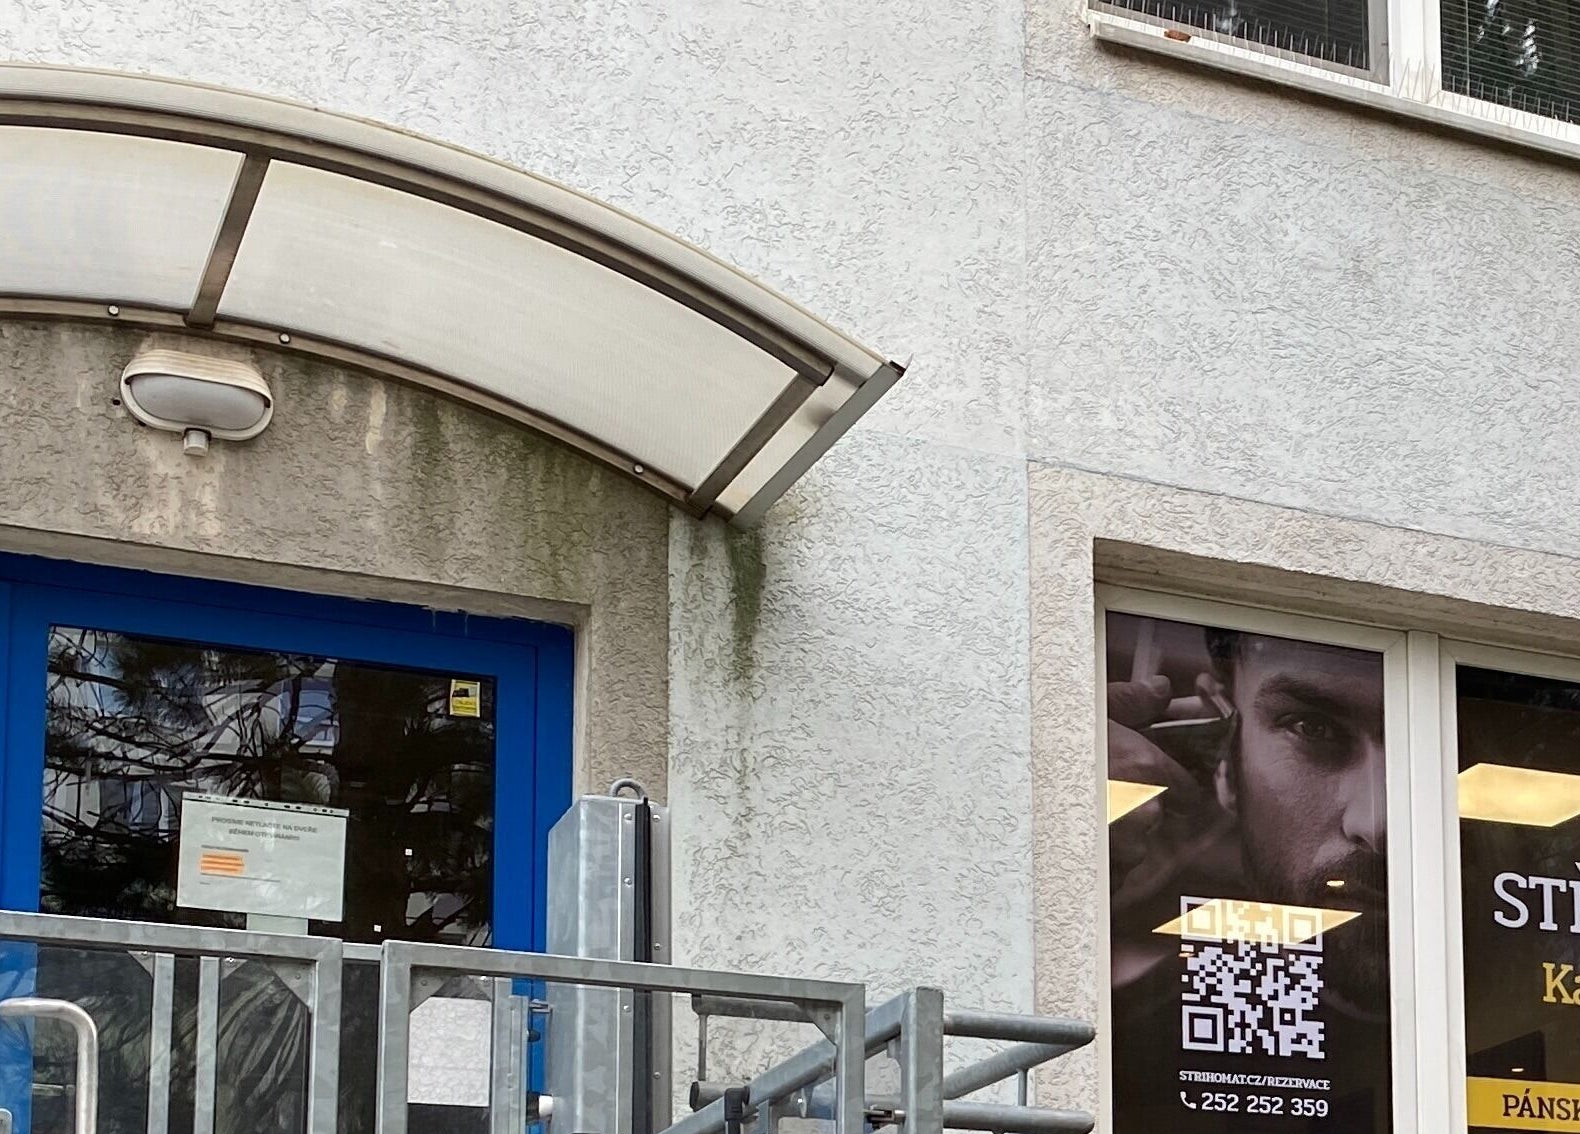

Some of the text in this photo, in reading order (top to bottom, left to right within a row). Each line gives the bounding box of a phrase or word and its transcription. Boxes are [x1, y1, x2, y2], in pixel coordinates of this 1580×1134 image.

[1179, 1070, 1331, 1091] STRIHOMAT.CZ/REZERVACE
[1201, 1092, 1329, 1118] 252 252 359
